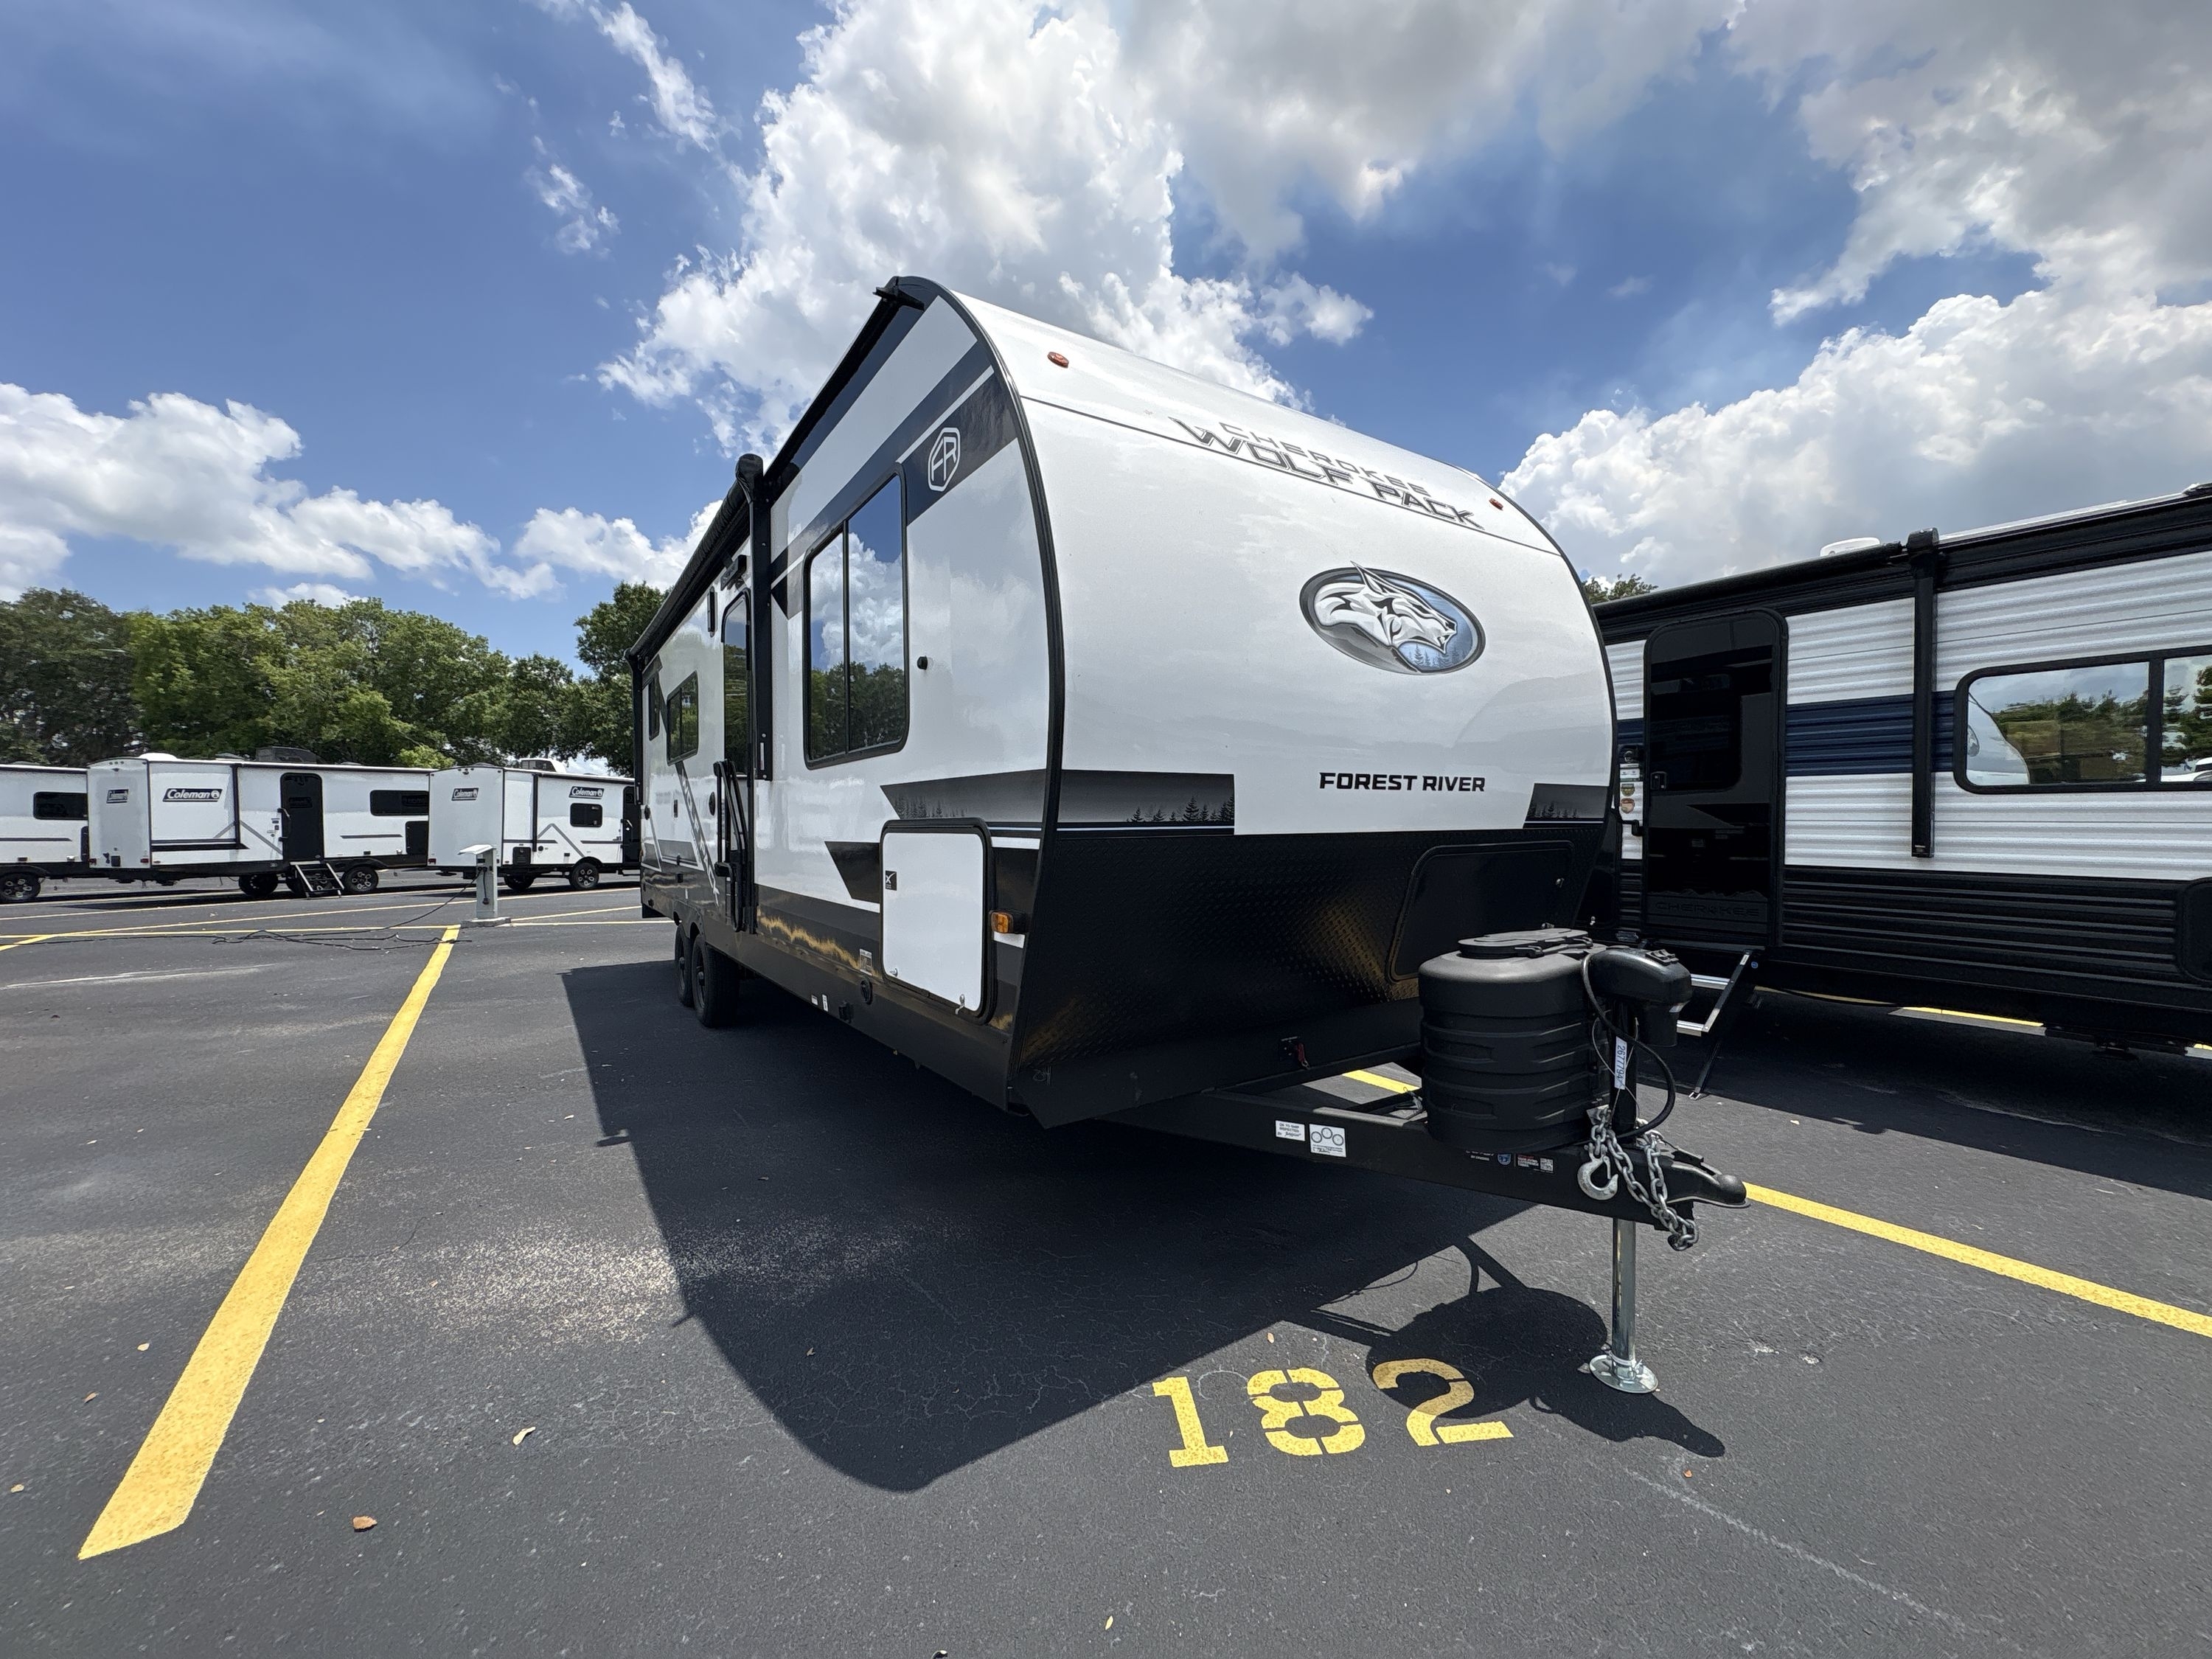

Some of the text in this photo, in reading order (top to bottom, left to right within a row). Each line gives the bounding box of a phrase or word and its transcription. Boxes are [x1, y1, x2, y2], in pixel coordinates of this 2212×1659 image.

[1168, 416, 1485, 530] WOLF PACK
[1219, 422, 1431, 498] CHEROKEE
[167, 789, 210, 799] Coleman
[571, 787, 598, 797] Coleman
[1319, 772, 1486, 792] FOREST RIVER
[1152, 1358, 1514, 1467] 182
